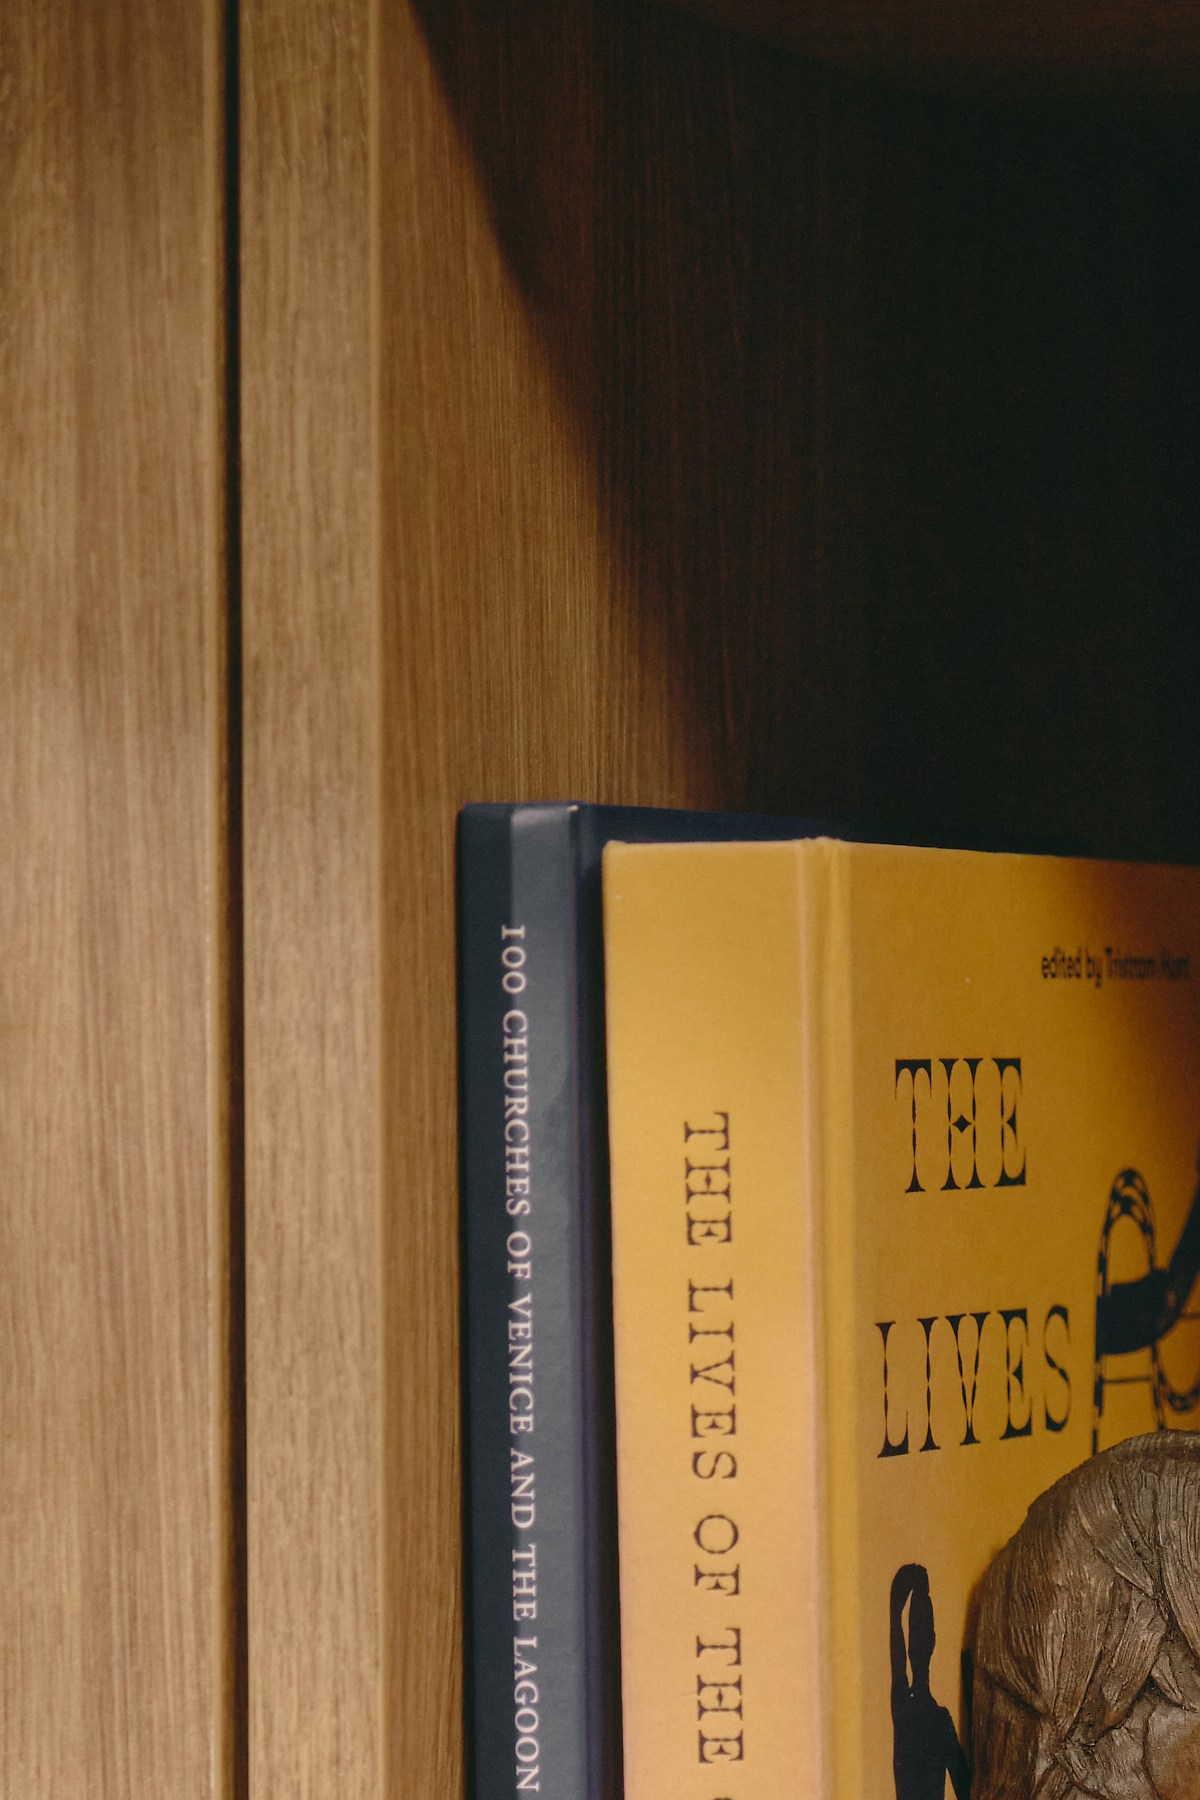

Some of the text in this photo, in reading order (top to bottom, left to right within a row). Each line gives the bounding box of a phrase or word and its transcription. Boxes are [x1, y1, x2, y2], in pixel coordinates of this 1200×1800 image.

[502, 924, 527, 994] 100
[1042, 947, 1082, 979] edited
[1084, 947, 1103, 988] by
[503, 1010, 530, 1216] CHURCHES
[684, 1111, 732, 1246] THE
[894, 1057, 1027, 1193] THE
[506, 1231, 531, 1279] OF
[508, 1293, 534, 1434] VENICE
[688, 1278, 738, 1479] LIVES
[875, 1304, 1072, 1458] LIVES
[510, 1448, 535, 1529] AND
[693, 1514, 740, 1596] OF
[512, 1544, 538, 1621] THE
[514, 1636, 539, 1792] LAGOON
[696, 1627, 744, 1764] THE
